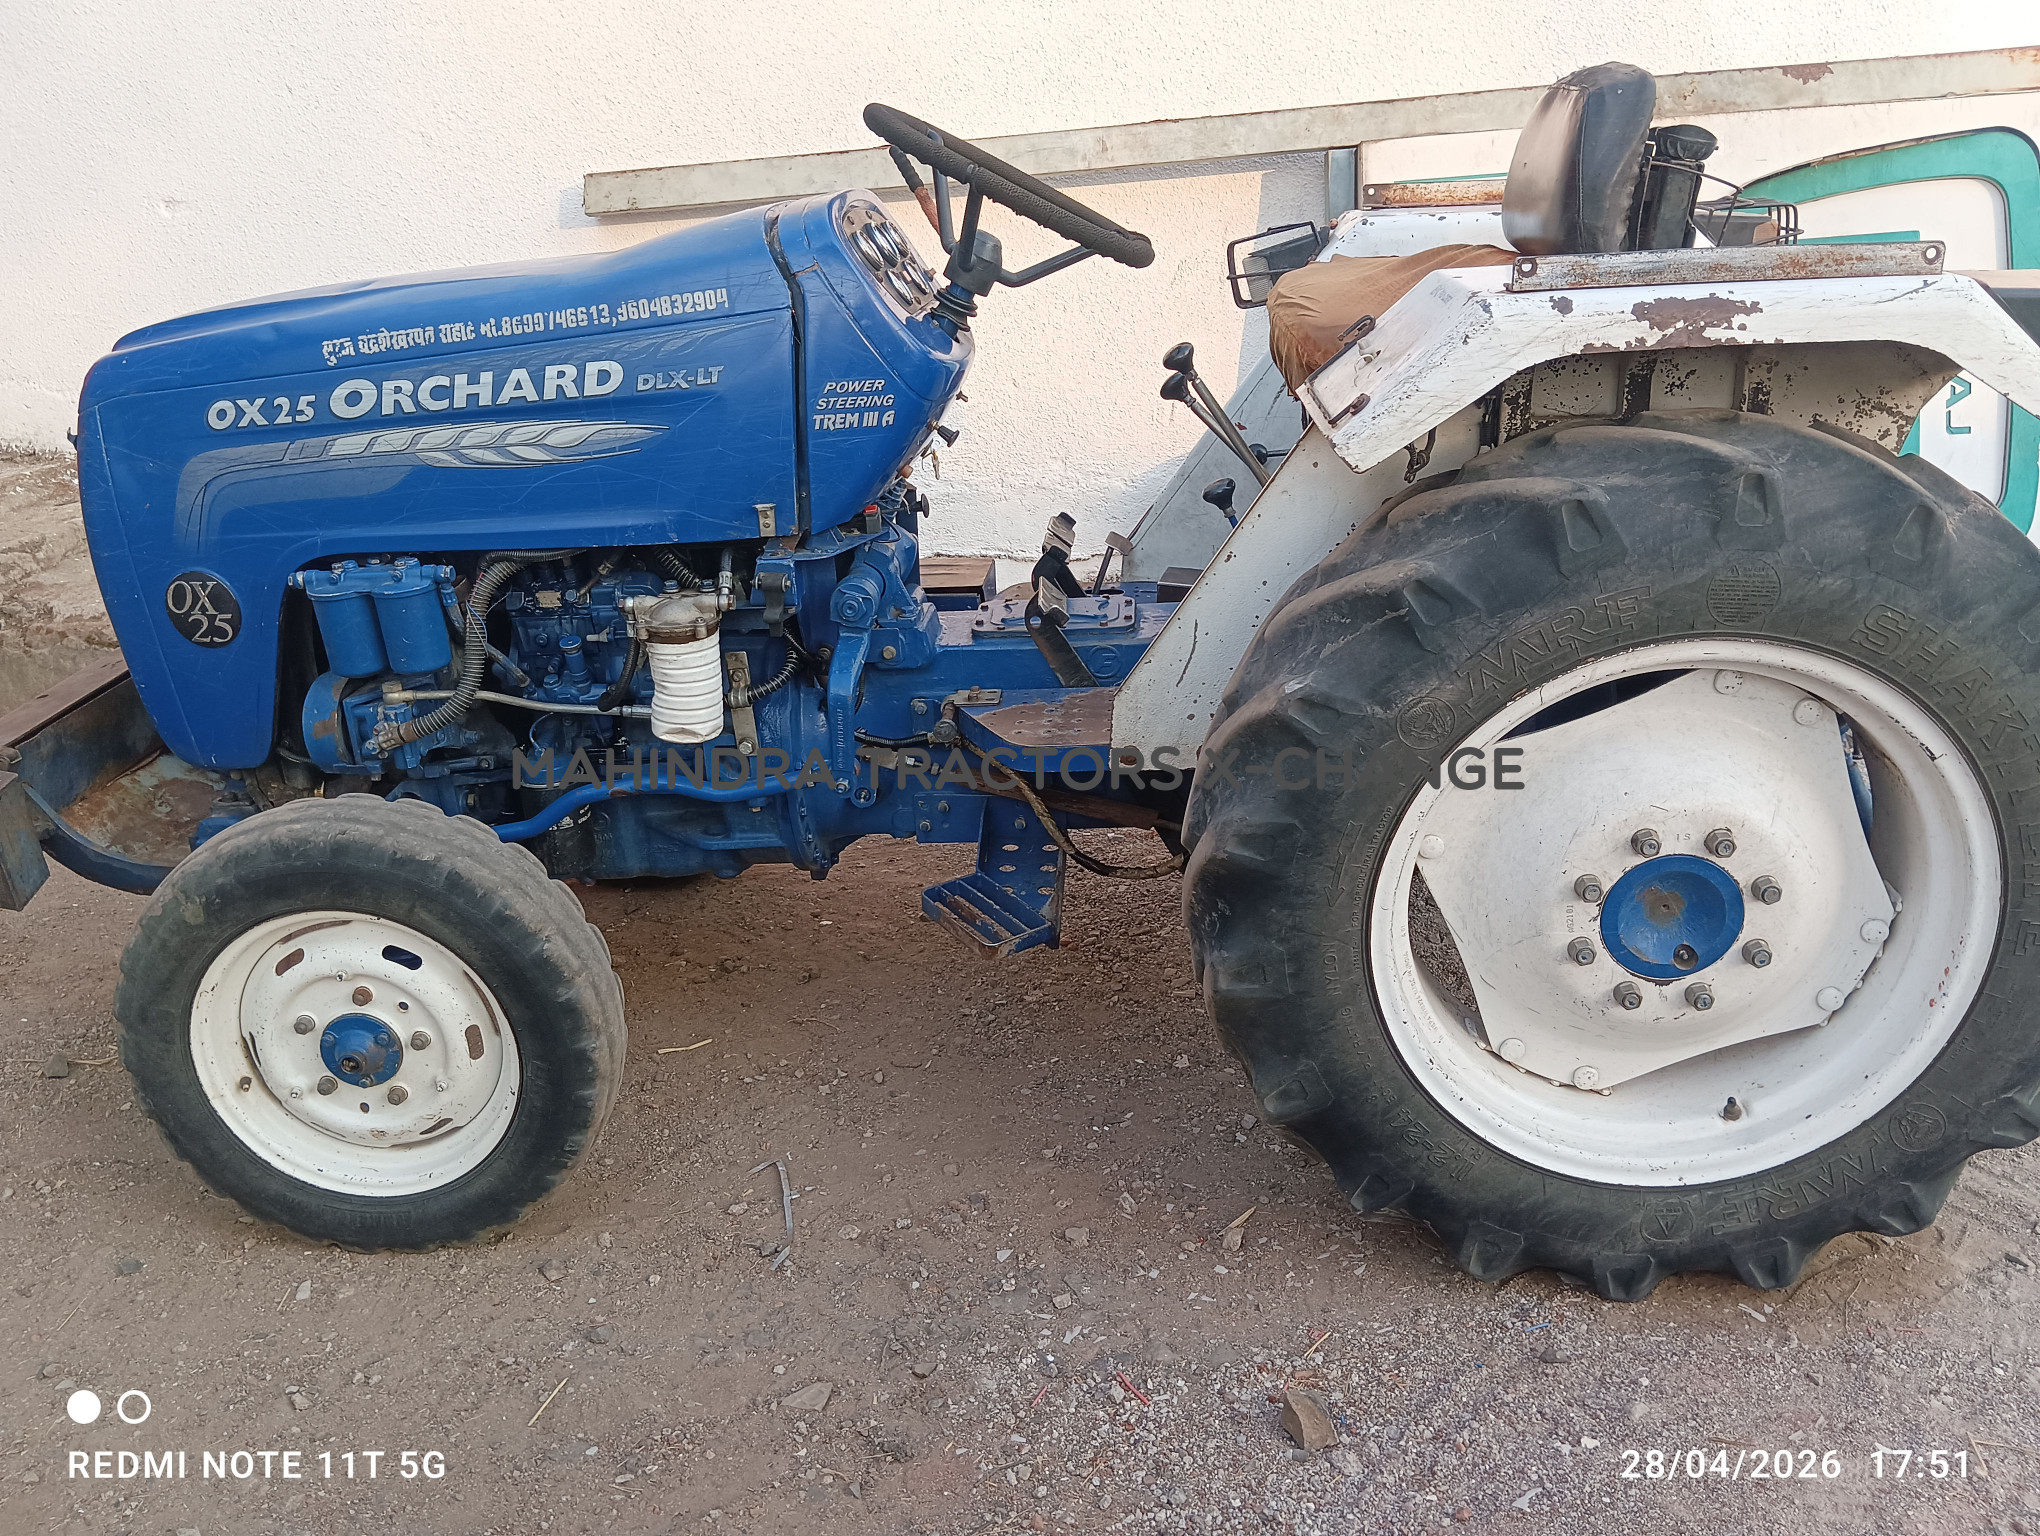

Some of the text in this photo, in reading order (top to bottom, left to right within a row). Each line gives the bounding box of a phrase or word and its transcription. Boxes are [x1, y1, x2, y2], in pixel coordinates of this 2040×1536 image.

[329, 359, 625, 420] ORCHARD
[636, 365, 725, 392] DLX-LT
[815, 393, 895, 410] STEERING
[823, 379, 886, 395] POWER
[812, 409, 896, 432] TREM III A
[166, 580, 220, 615] OX
[187, 613, 234, 643] 25
[1323, 942, 1343, 997] NYLON
[1390, 1108, 1476, 1181] 11.2-24
